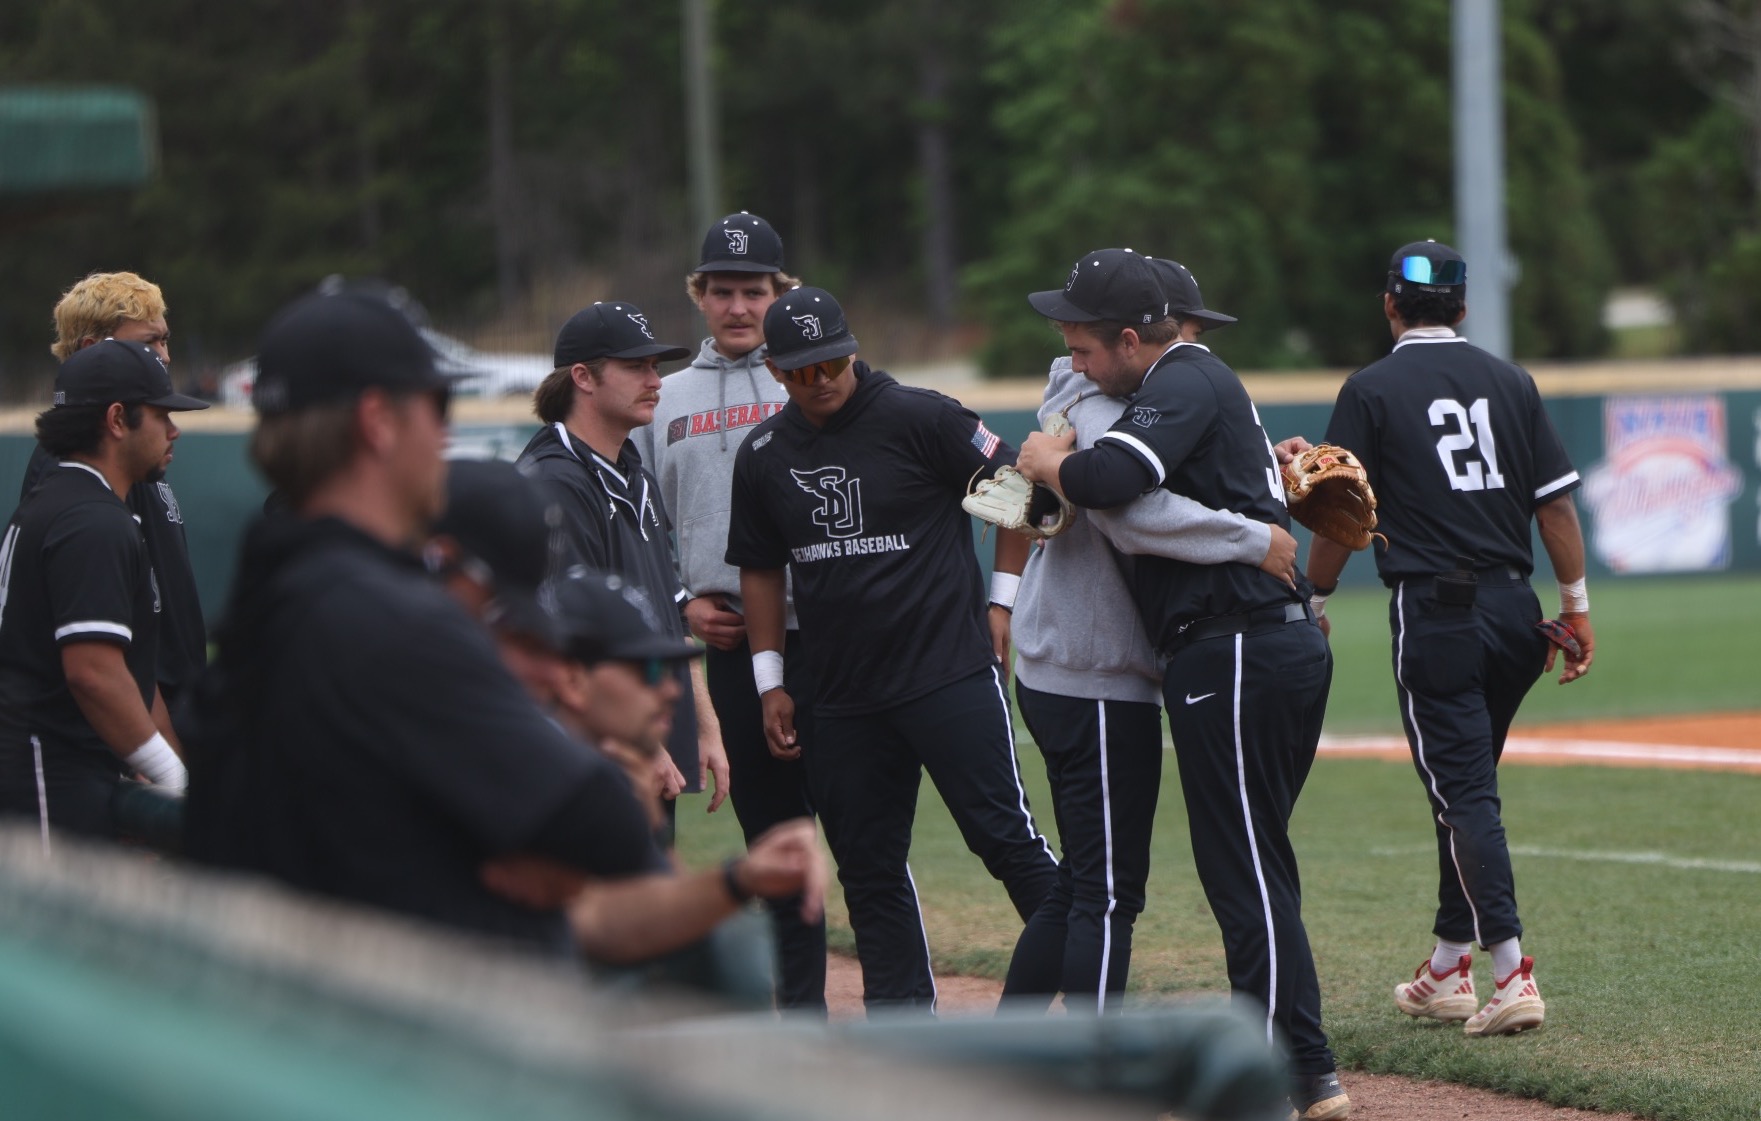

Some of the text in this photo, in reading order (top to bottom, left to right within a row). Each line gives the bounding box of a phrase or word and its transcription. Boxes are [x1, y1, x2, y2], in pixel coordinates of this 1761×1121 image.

[690, 402, 785, 436] BASEBA
[1427, 398, 1505, 492] 21
[789, 465, 863, 539] SU
[844, 533, 911, 556] BASEBALL
